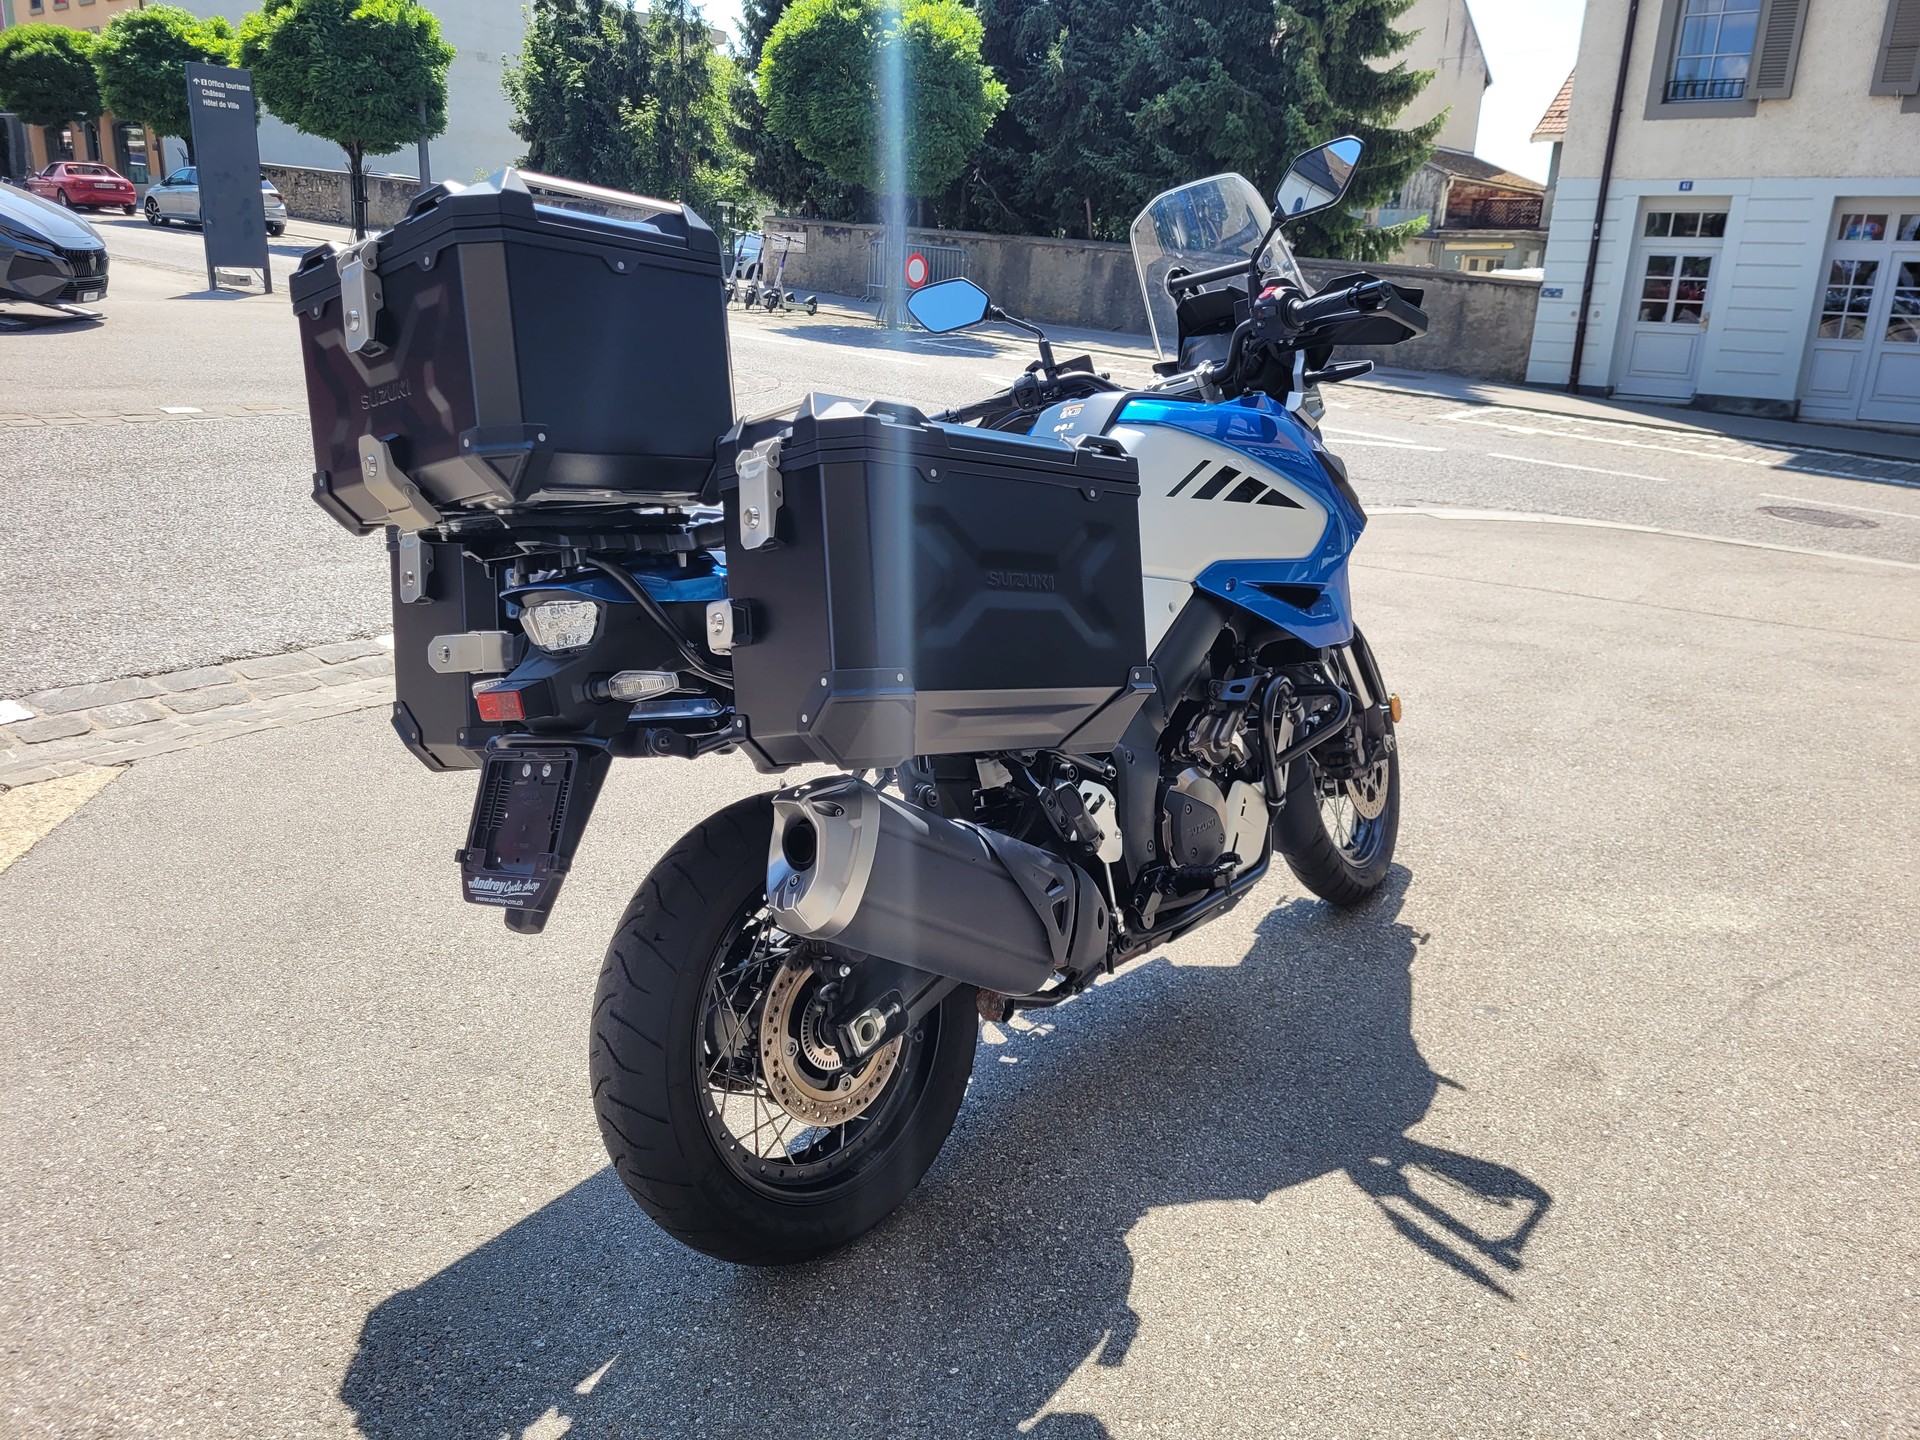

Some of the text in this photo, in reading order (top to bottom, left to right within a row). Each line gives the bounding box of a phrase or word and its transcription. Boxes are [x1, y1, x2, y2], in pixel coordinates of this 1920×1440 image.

[201, 88, 226, 98] Château
[207, 79, 251, 92] Office tourisme
[202, 99, 218, 108] Hôtel
[227, 101, 240, 110] Ville
[360, 379, 412, 410] SUZUKI
[986, 571, 1055, 590] SUZUKI
[470, 876, 506, 893] Andrey
[522, 879, 540, 892] shop
